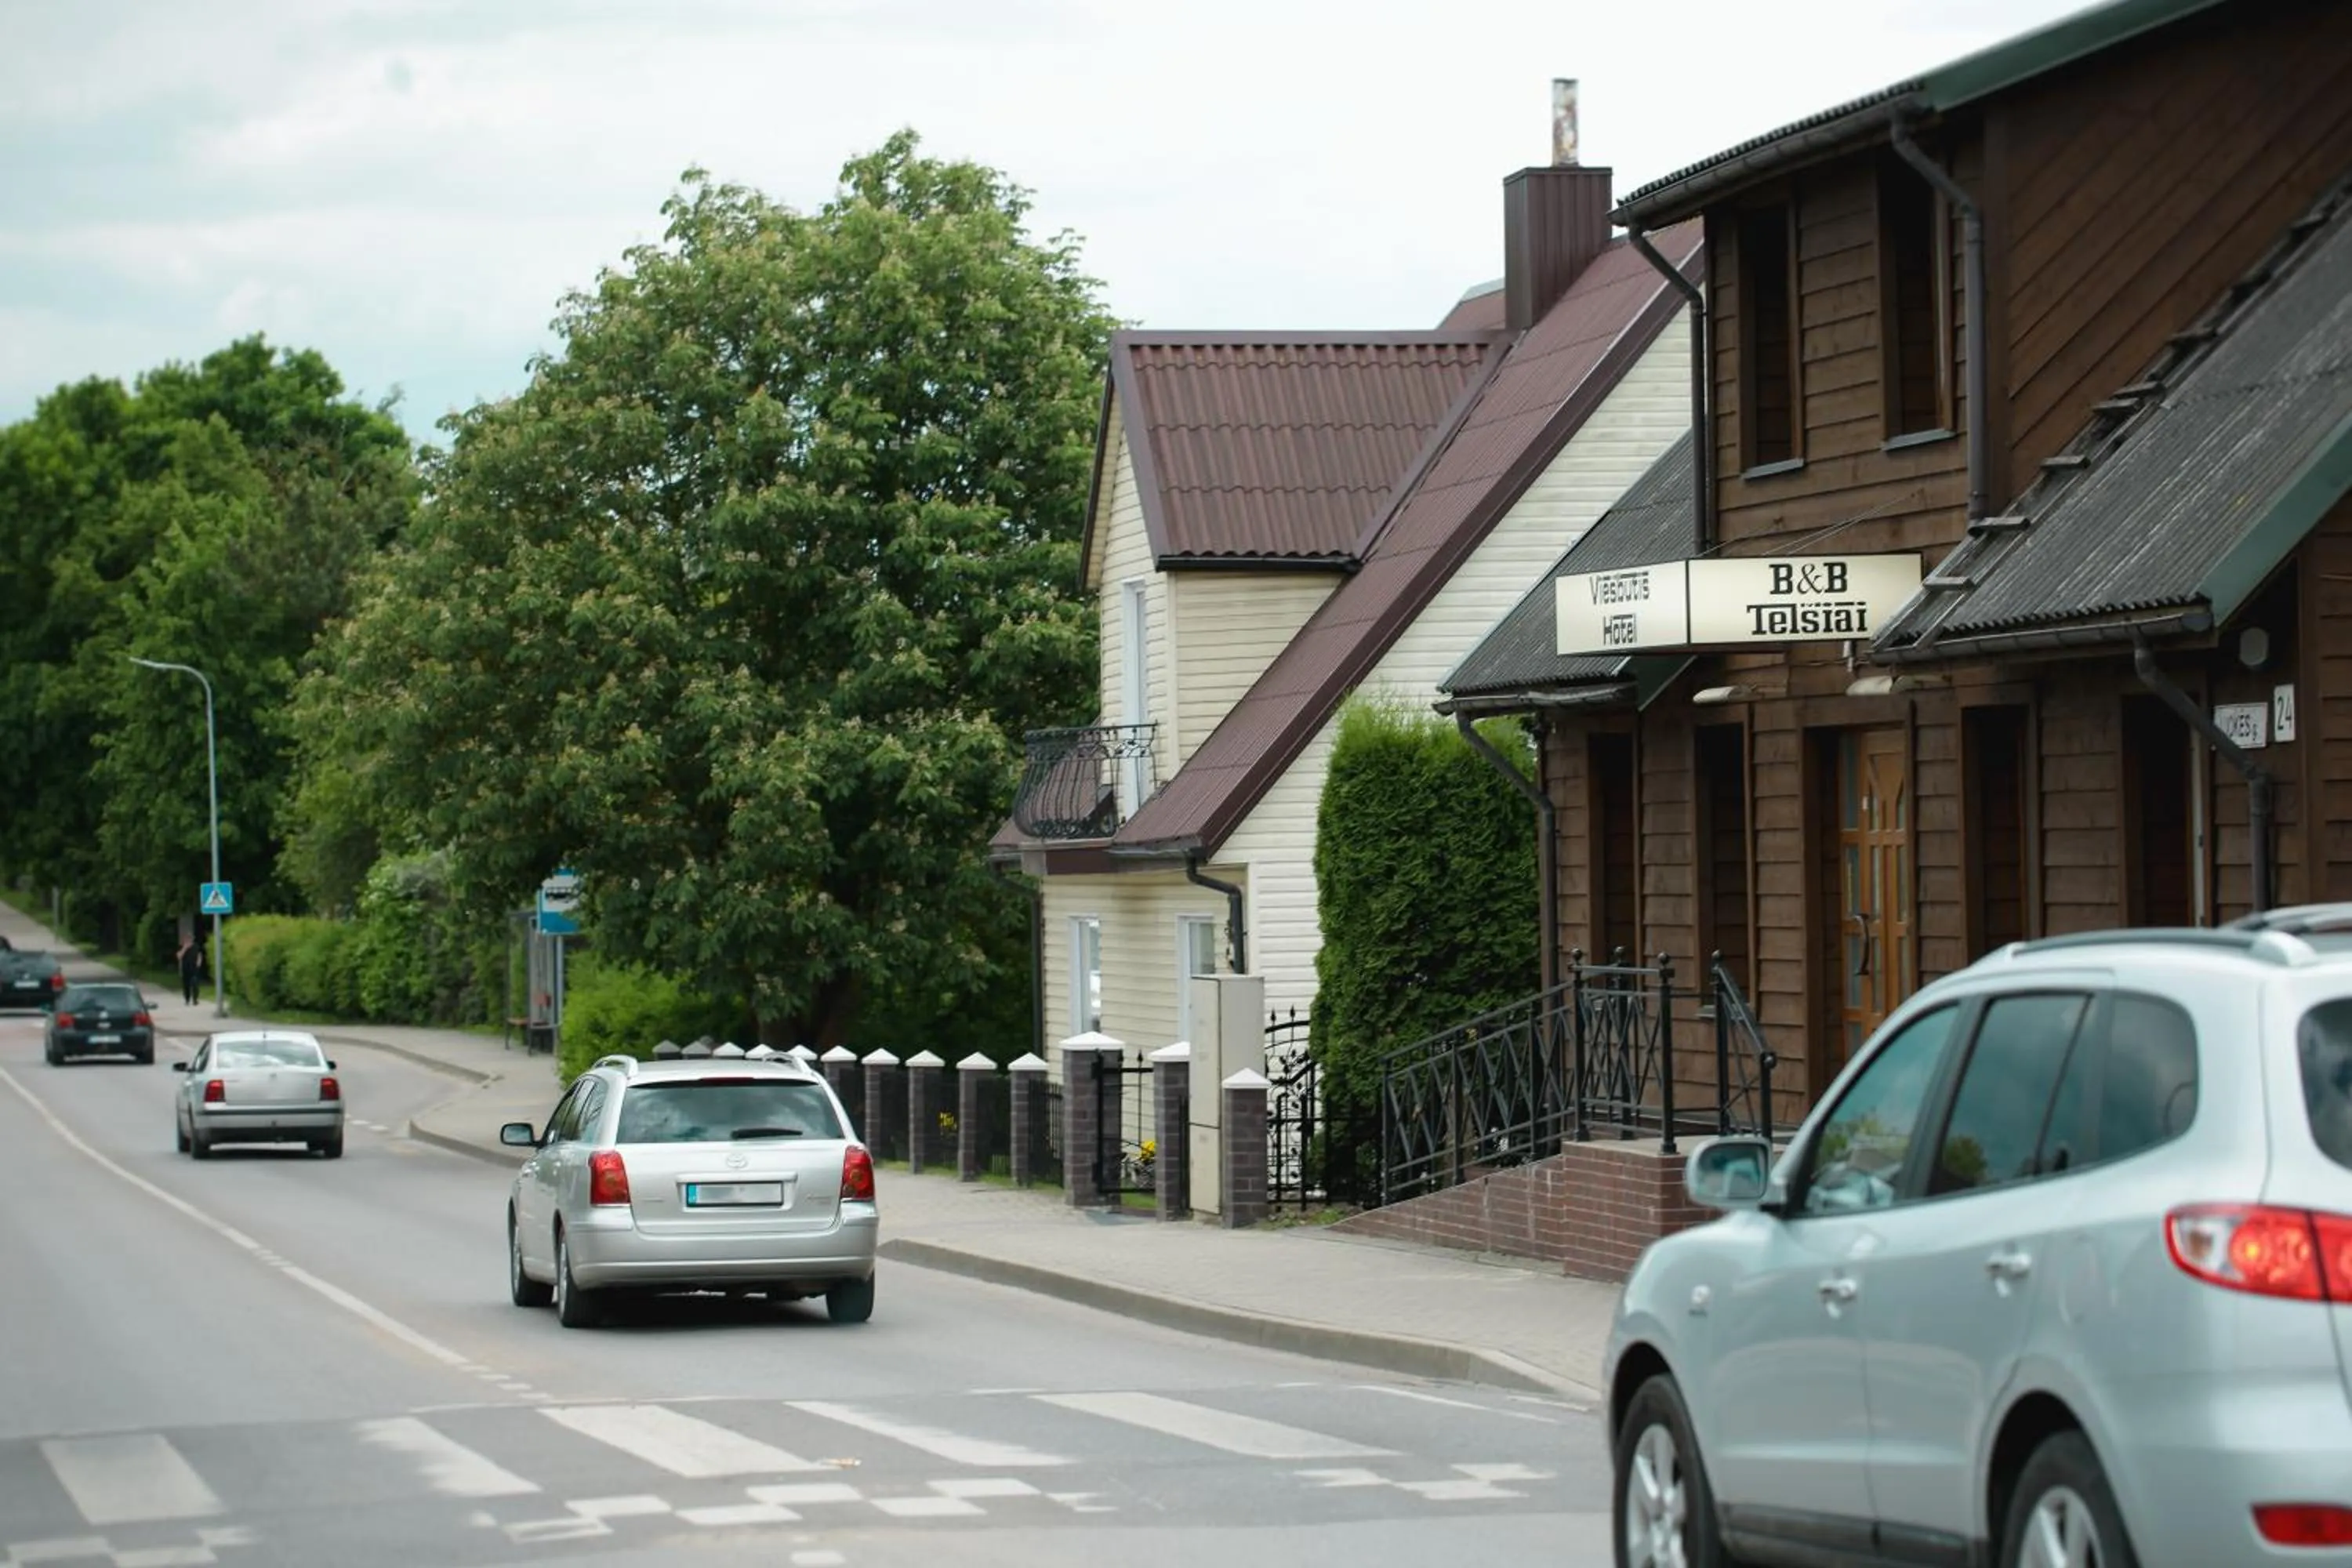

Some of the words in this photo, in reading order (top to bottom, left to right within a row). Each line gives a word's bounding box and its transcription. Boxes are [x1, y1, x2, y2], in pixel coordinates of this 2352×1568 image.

[1769, 561, 1849, 595] B&B
[1603, 613, 1637, 645] Hotel
[2277, 695, 2293, 731] 24
